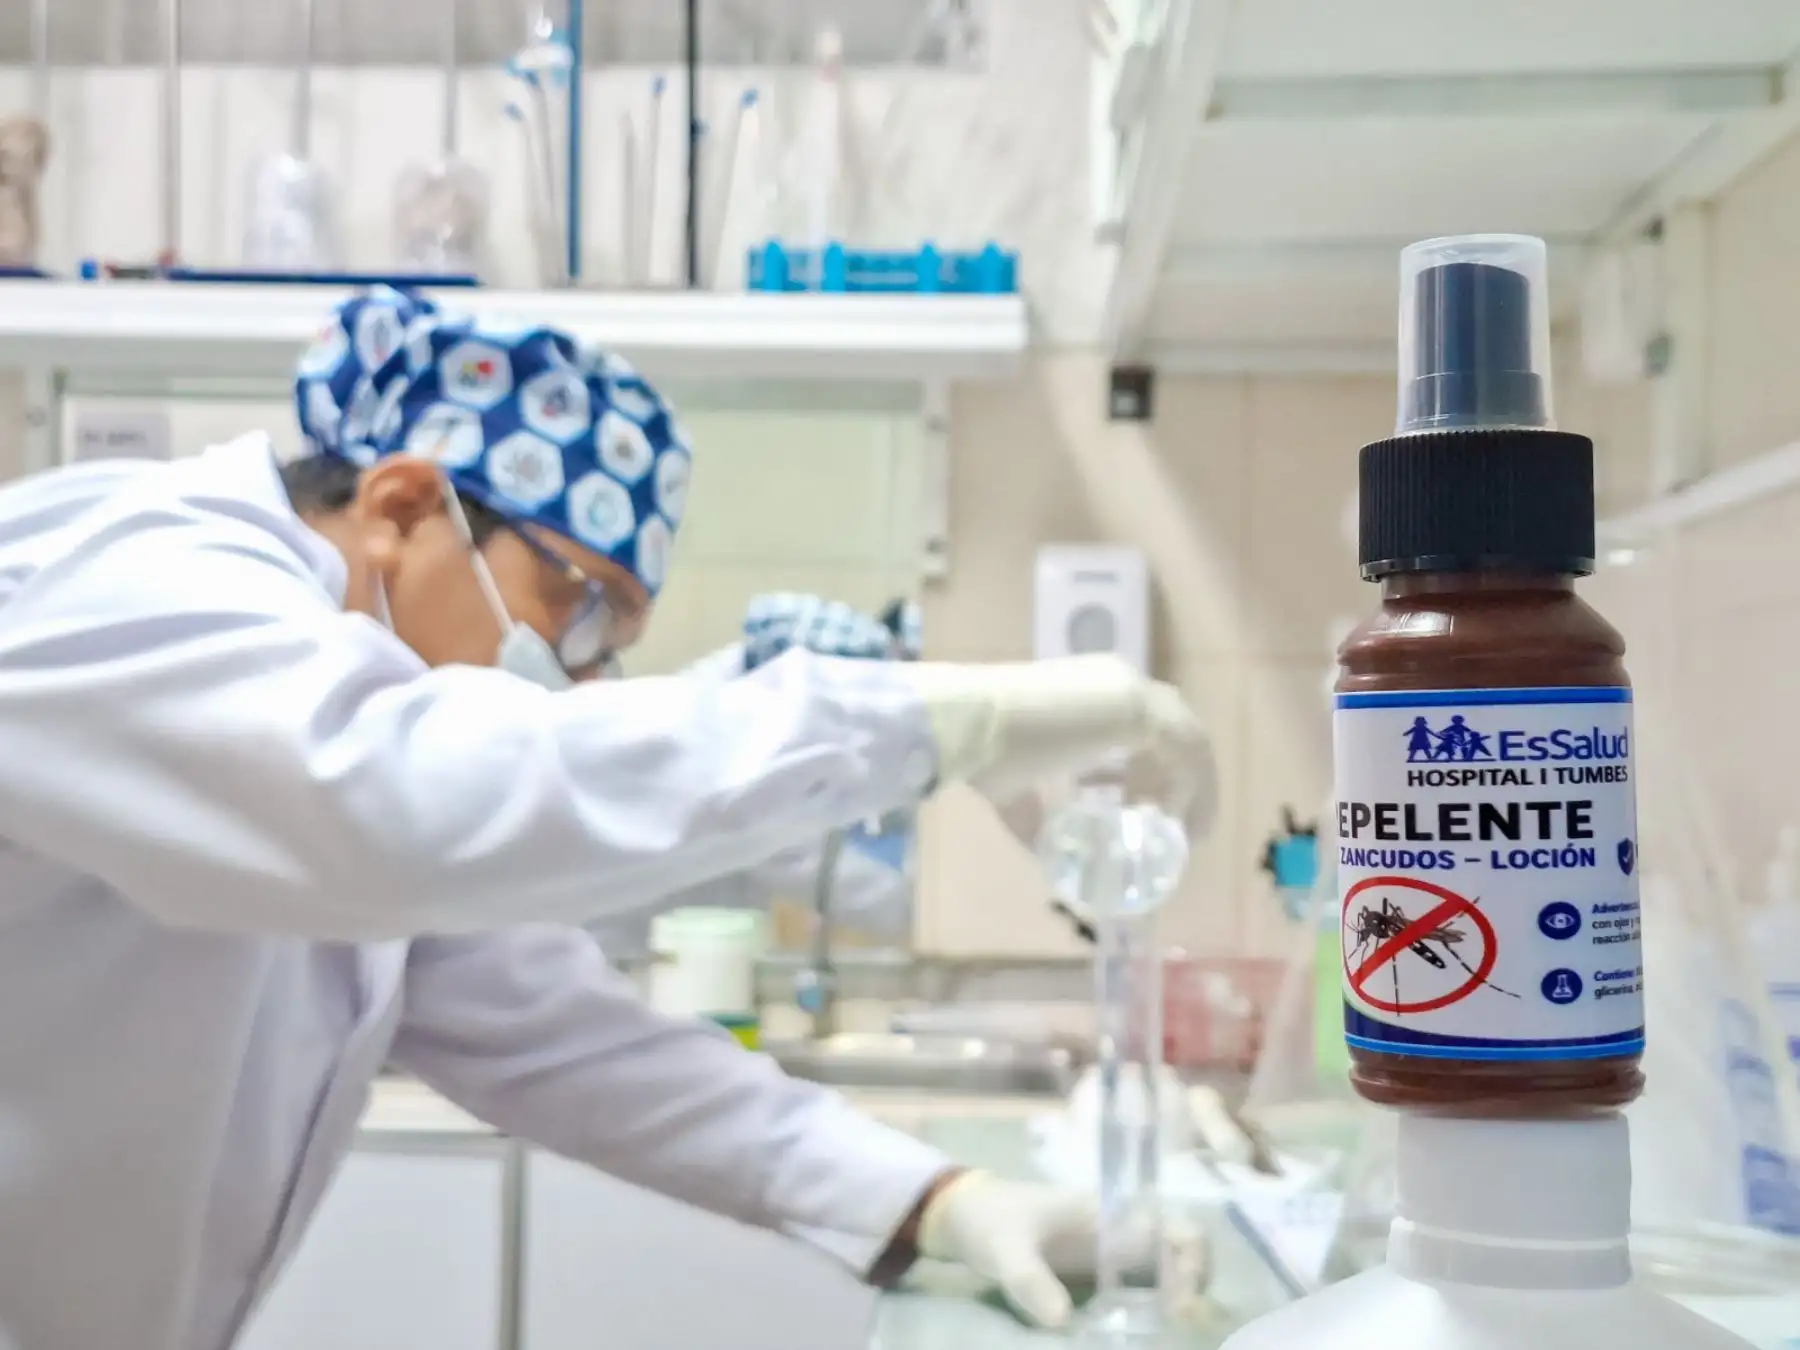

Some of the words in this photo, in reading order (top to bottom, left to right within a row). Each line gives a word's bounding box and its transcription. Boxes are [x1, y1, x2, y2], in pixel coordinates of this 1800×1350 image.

[1499, 726, 1628, 761] EsSalud
[1408, 768, 1532, 787] HOSPITAL
[1540, 768, 1547, 785] I
[1554, 766, 1628, 784] TUMBES
[1336, 801, 1593, 840] EPELENTE
[1341, 846, 1455, 870] ZANCUDOS
[1491, 843, 1594, 869] LOCIÓN
